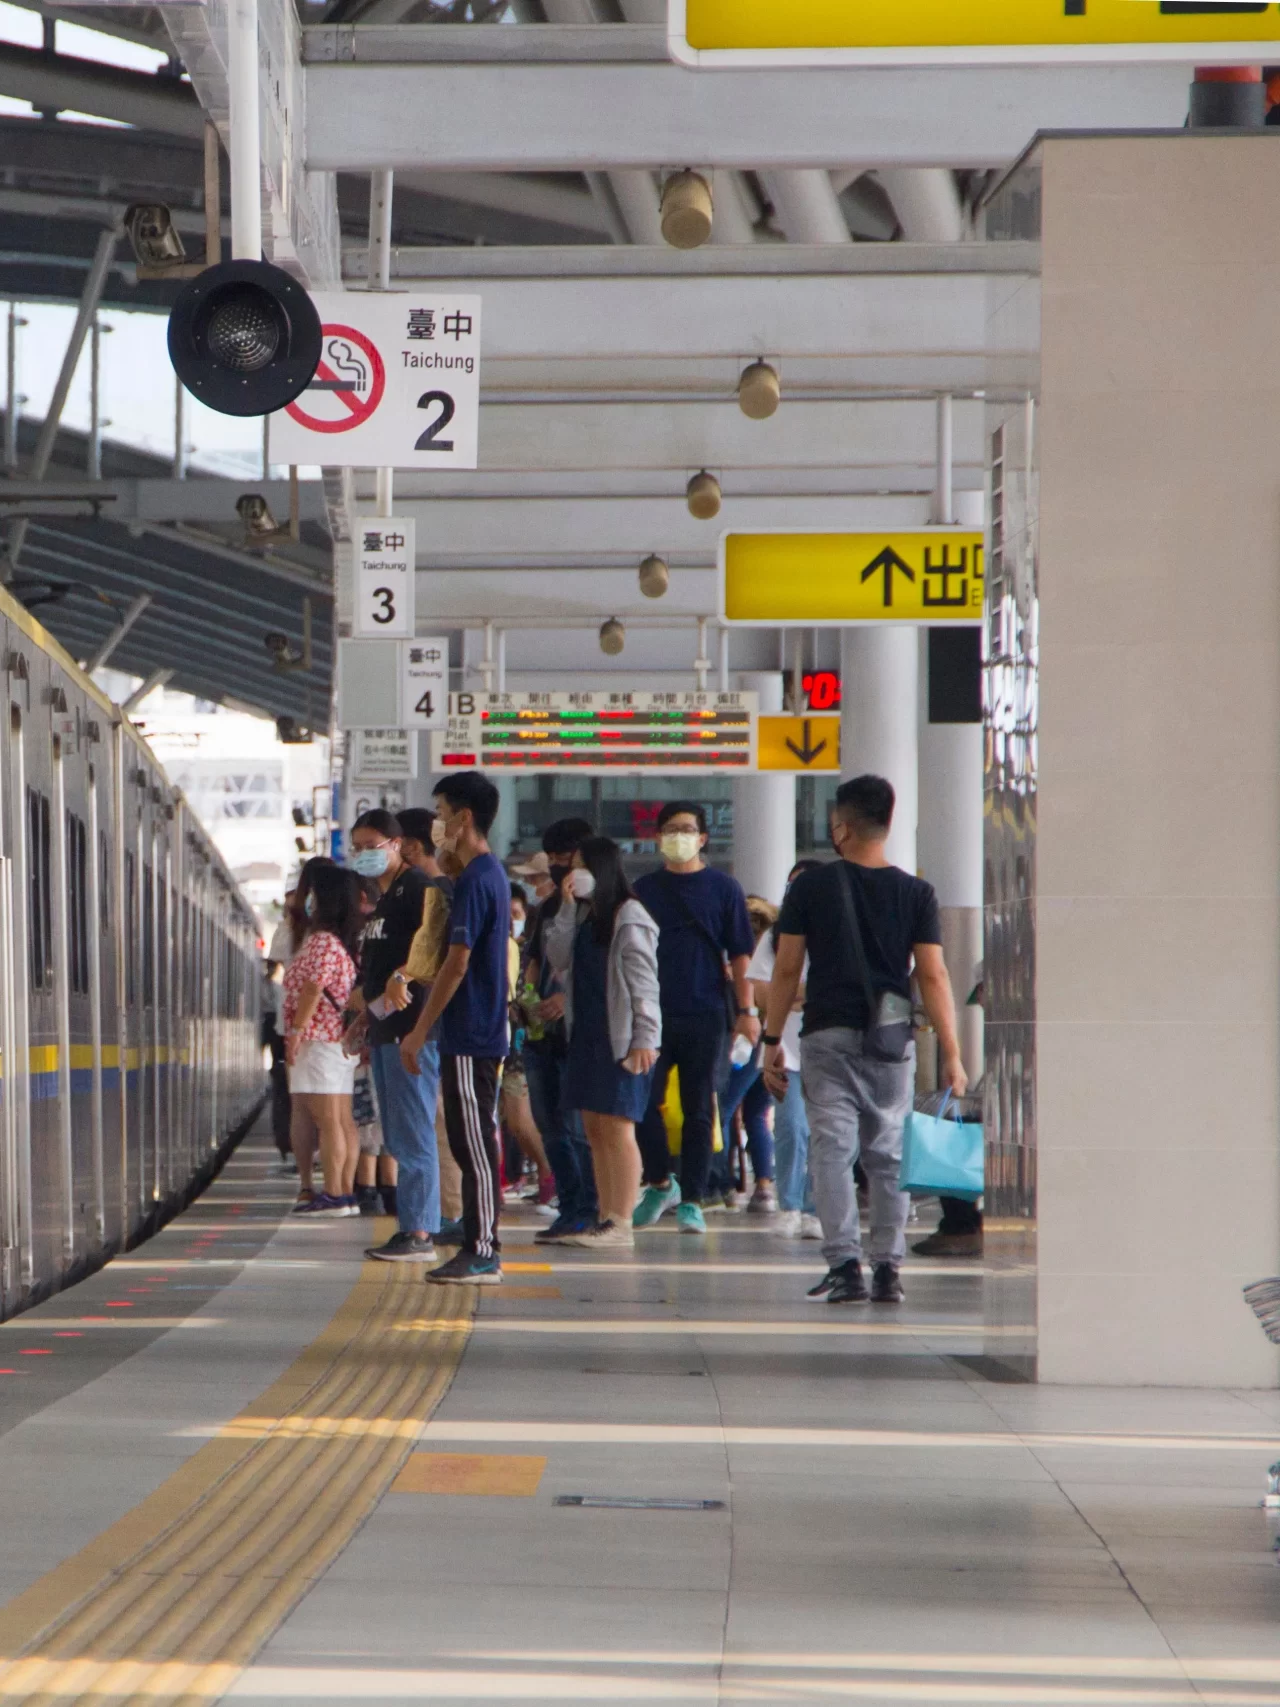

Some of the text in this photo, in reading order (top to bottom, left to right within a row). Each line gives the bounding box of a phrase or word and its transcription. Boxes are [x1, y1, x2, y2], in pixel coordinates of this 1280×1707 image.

[407, 308, 472, 341] 臺中
[402, 351, 475, 374] Taichung
[414, 390, 455, 452] 2
[363, 532, 404, 552] 臺中
[362, 561, 407, 571] Taichung
[922, 543, 984, 606] 出
[372, 587, 396, 624] 3
[410, 648, 441, 665] 臺中
[415, 690, 435, 718] 4
